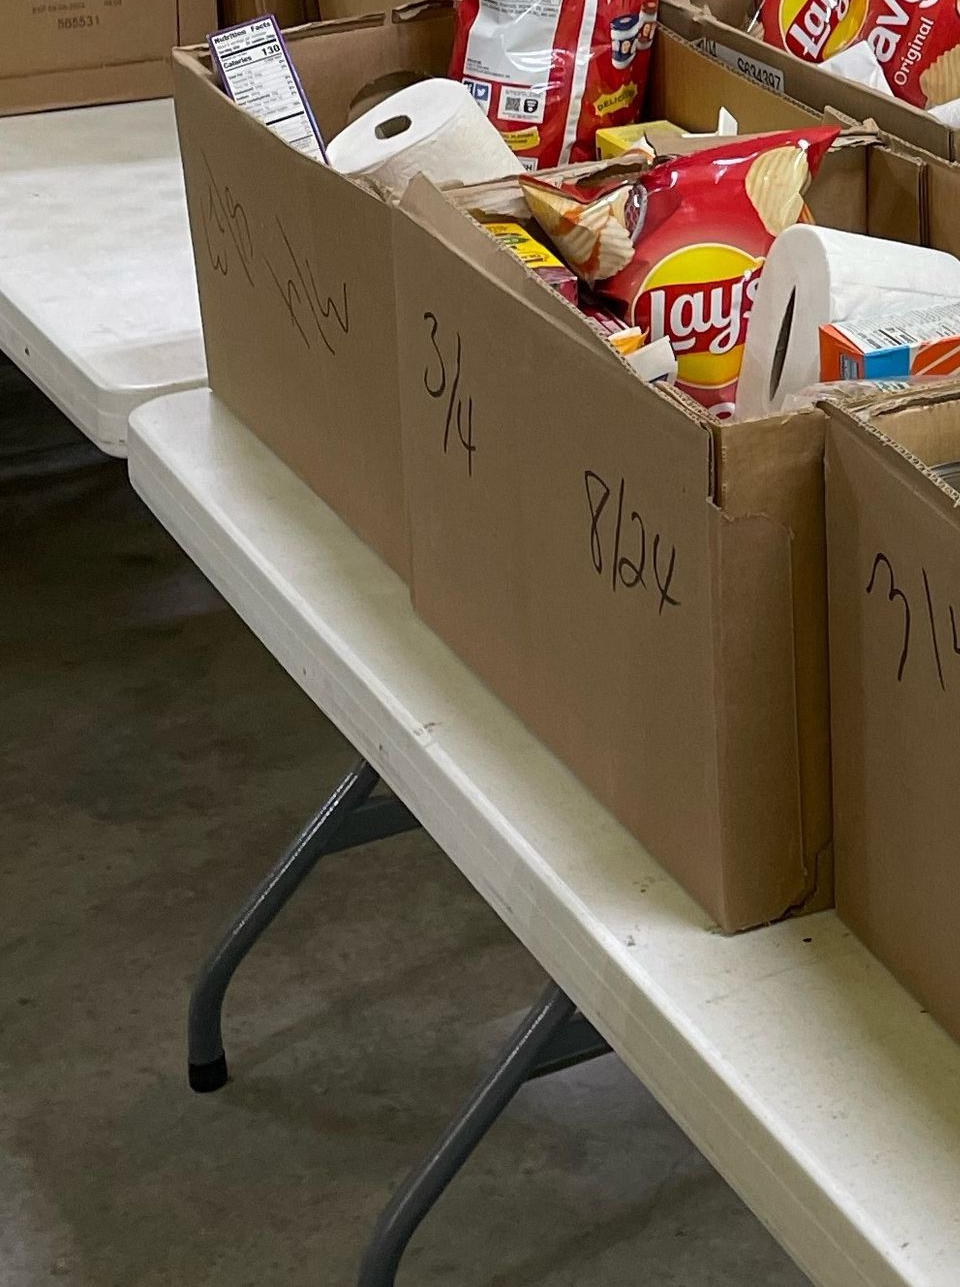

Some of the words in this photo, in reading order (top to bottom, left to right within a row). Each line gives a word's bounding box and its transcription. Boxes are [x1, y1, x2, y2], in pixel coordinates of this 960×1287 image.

[214, 29, 247, 45] Nutrition
[250, 21, 271, 33] Facts
[223, 55, 253, 69] Calories
[262, 44, 280, 56] 130
[893, 16, 935, 86] Original
[423, 311, 476, 479] 3/4
[584, 470, 682, 615] 8/24
